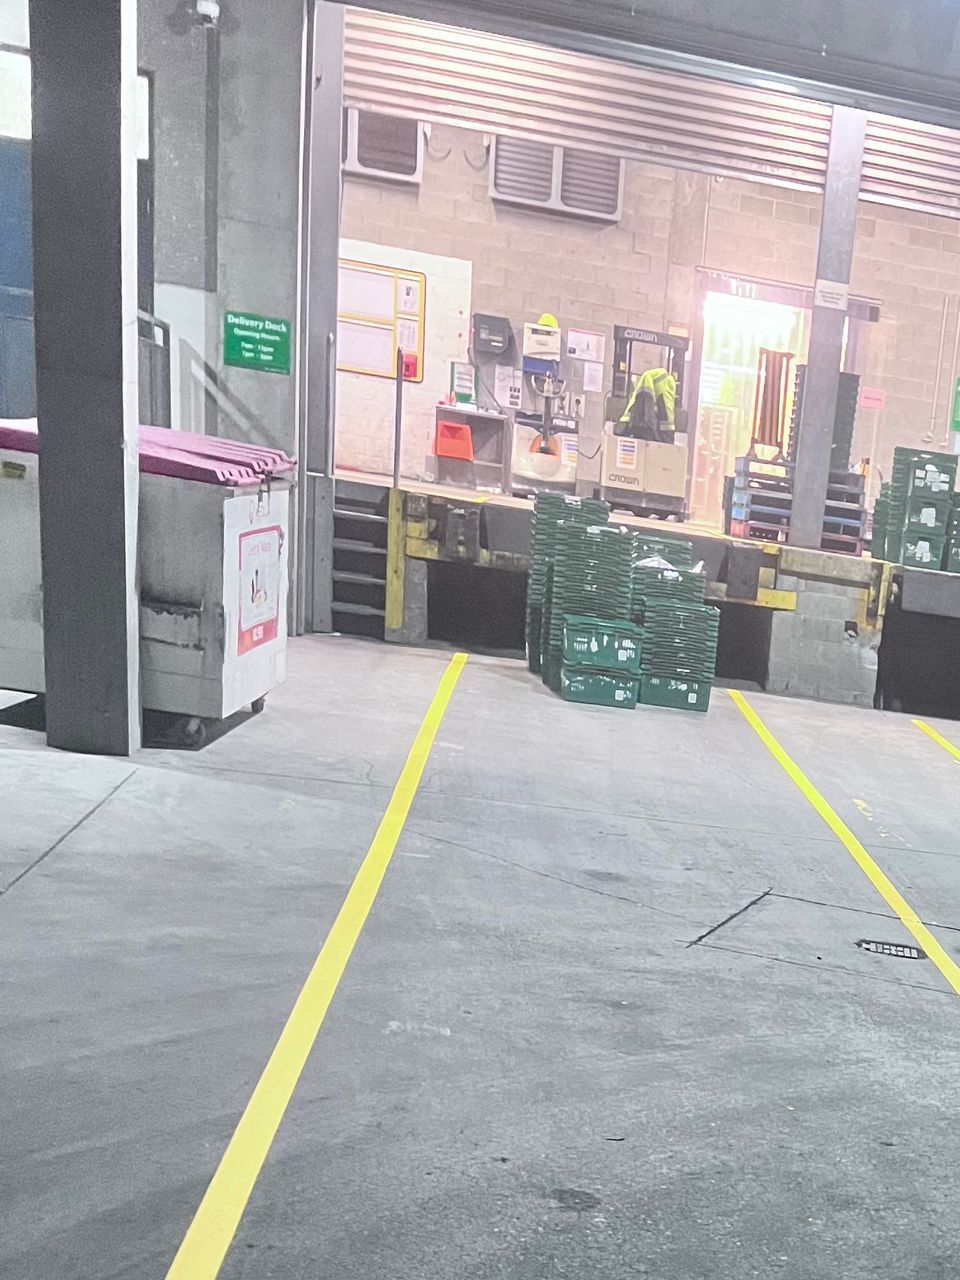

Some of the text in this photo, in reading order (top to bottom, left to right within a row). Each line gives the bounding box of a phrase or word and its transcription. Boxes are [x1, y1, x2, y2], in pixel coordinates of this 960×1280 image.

[227, 314, 287, 332] Delivery Dock
[624, 328, 657, 343] CROWN
[608, 473, 640, 486] CROWN
